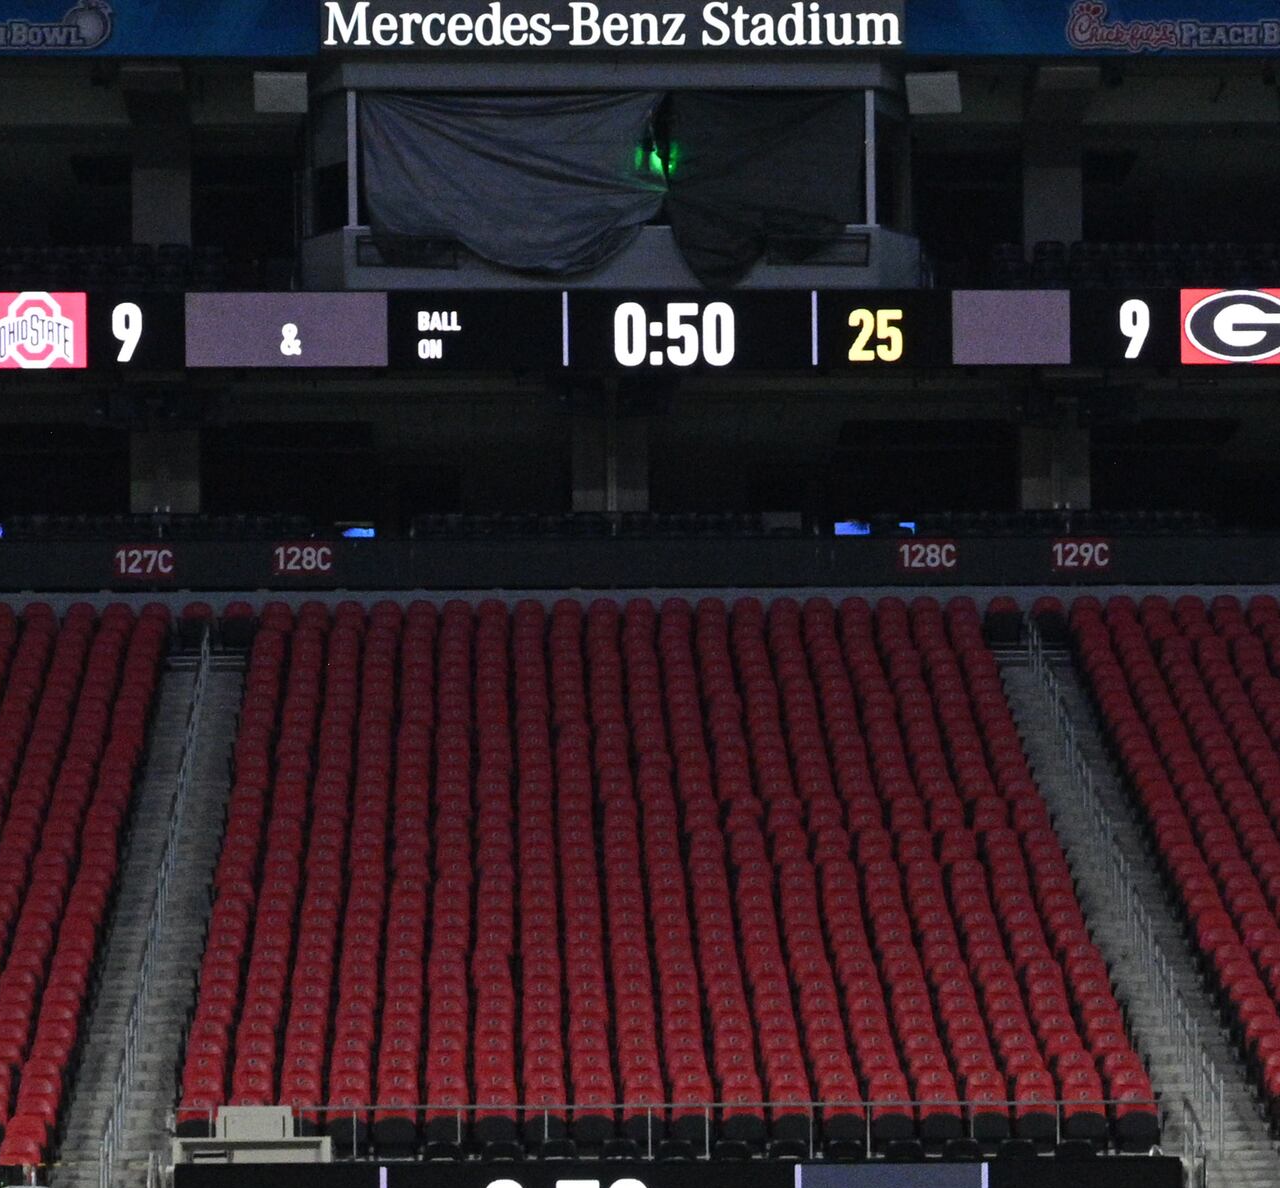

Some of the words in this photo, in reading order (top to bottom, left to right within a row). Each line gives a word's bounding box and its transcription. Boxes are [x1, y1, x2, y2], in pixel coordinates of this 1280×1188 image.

[10, 20, 84, 46] BOWL
[324, 2, 687, 46] Mercedes-Benz
[701, 1, 903, 46] Stadium
[1179, 21, 1260, 46] PEACH
[111, 303, 144, 363] 9
[417, 311, 463, 331] BALL
[1120, 299, 1151, 361] 9
[30, 314, 71, 359] STATE
[280, 323, 303, 357] &
[613, 302, 736, 368] 0:50
[847, 308, 904, 362] 25
[417, 339, 444, 360] ON
[115, 550, 174, 574] 127C
[273, 546, 332, 571] 128C
[899, 543, 957, 568] 128C
[1051, 543, 1109, 567] 129C
